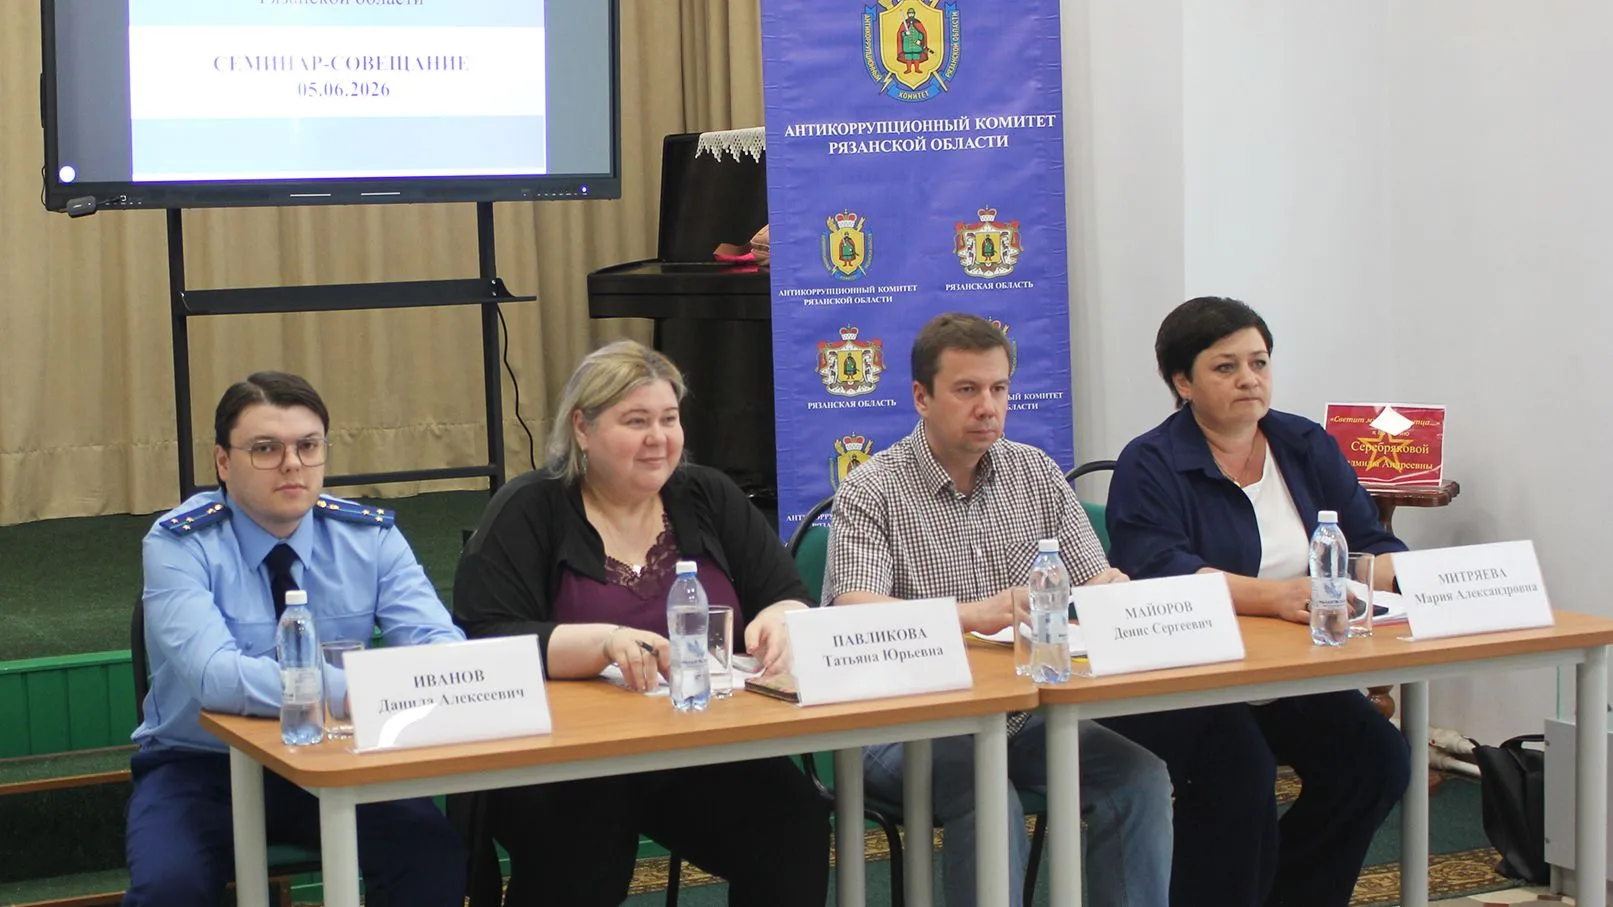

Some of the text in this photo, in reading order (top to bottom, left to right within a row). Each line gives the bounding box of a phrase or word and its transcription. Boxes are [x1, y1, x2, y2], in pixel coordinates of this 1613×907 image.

[213, 56, 470, 72] СЕМИНАР-СОВЕЩАНИЕ
[298, 82, 390, 97] 05.06.2026
[785, 114, 1056, 137] АНТИКОРРУПЦИОННЫЙ КОМИТЕТ
[828, 135, 1009, 155] РЯЗАНСКОЙ ОБЛАСТИ
[778, 284, 918, 297] АНТИКОРРУПЦИОННЫЙ КОМИТЕТ
[945, 281, 1034, 291] РЯЗАНСКАЯ ОБЛАСТЬ
[804, 296, 893, 306] РЯЗАНСКОЙ ОБЛАСТИ
[807, 399, 897, 410] РЯЗАНСКАЯ ОБЛАСТЬ
[1024, 392, 1063, 400] КОМИТЕТ
[1351, 441, 1429, 455] Серебряковой
[1438, 567, 1508, 585] МИТРЯЕВА
[1414, 584, 1537, 606] Мария Александровна
[1125, 601, 1193, 619] МАЙОРОВ
[833, 628, 927, 647] ПАВЛИКОВА
[1114, 619, 1212, 640] Денис Сергеевич
[823, 647, 944, 668] Татьяна Юрьевна
[413, 669, 486, 689] ИВАНОВ
[379, 688, 524, 714] Данила Алексеевич
